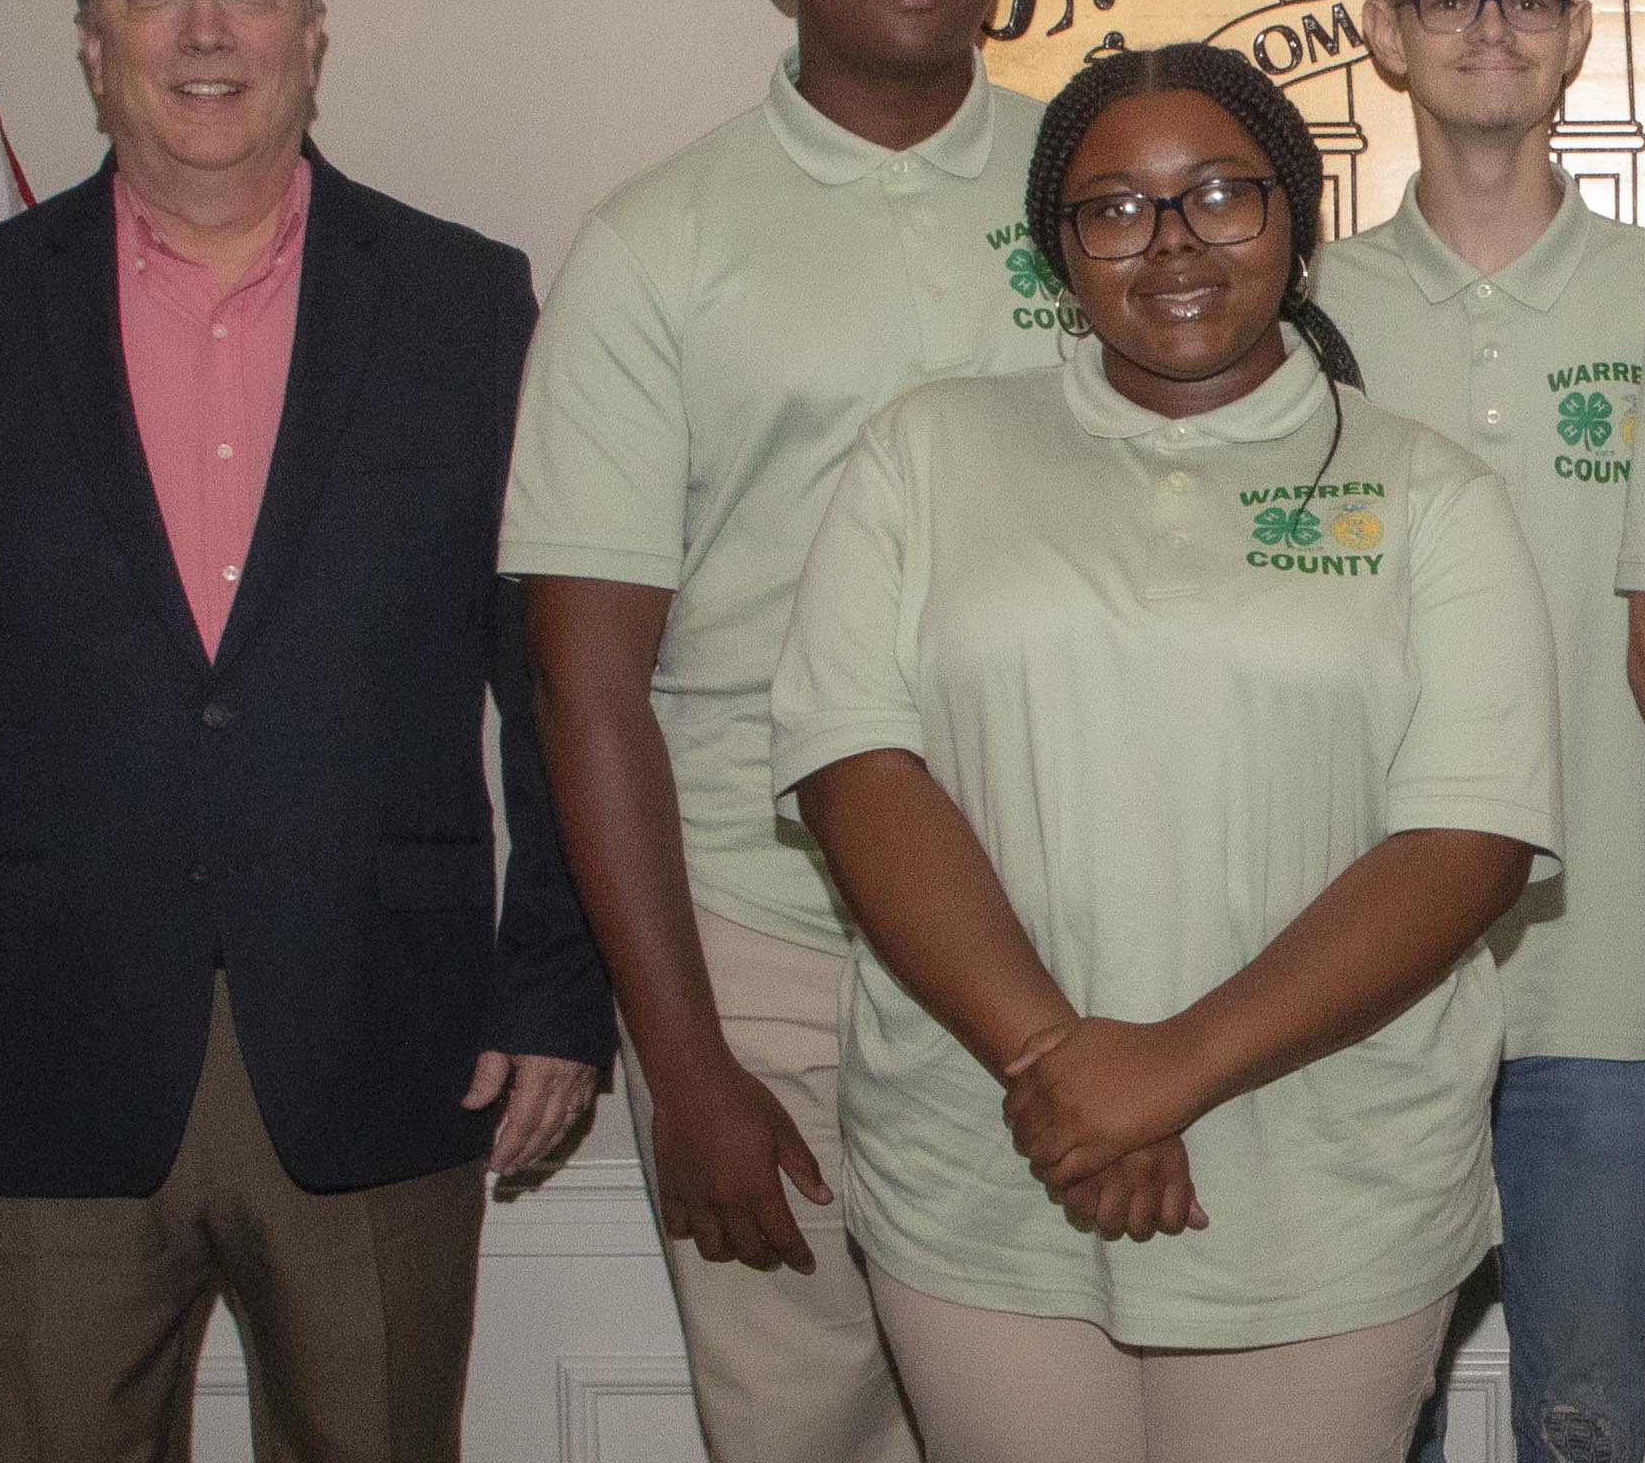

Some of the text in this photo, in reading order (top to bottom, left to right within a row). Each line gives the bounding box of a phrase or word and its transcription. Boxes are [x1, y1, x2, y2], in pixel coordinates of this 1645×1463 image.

[1252, 2, 1365, 76] OM
[1239, 481, 1386, 507] WARREN
[1246, 551, 1385, 577] COUNTY
